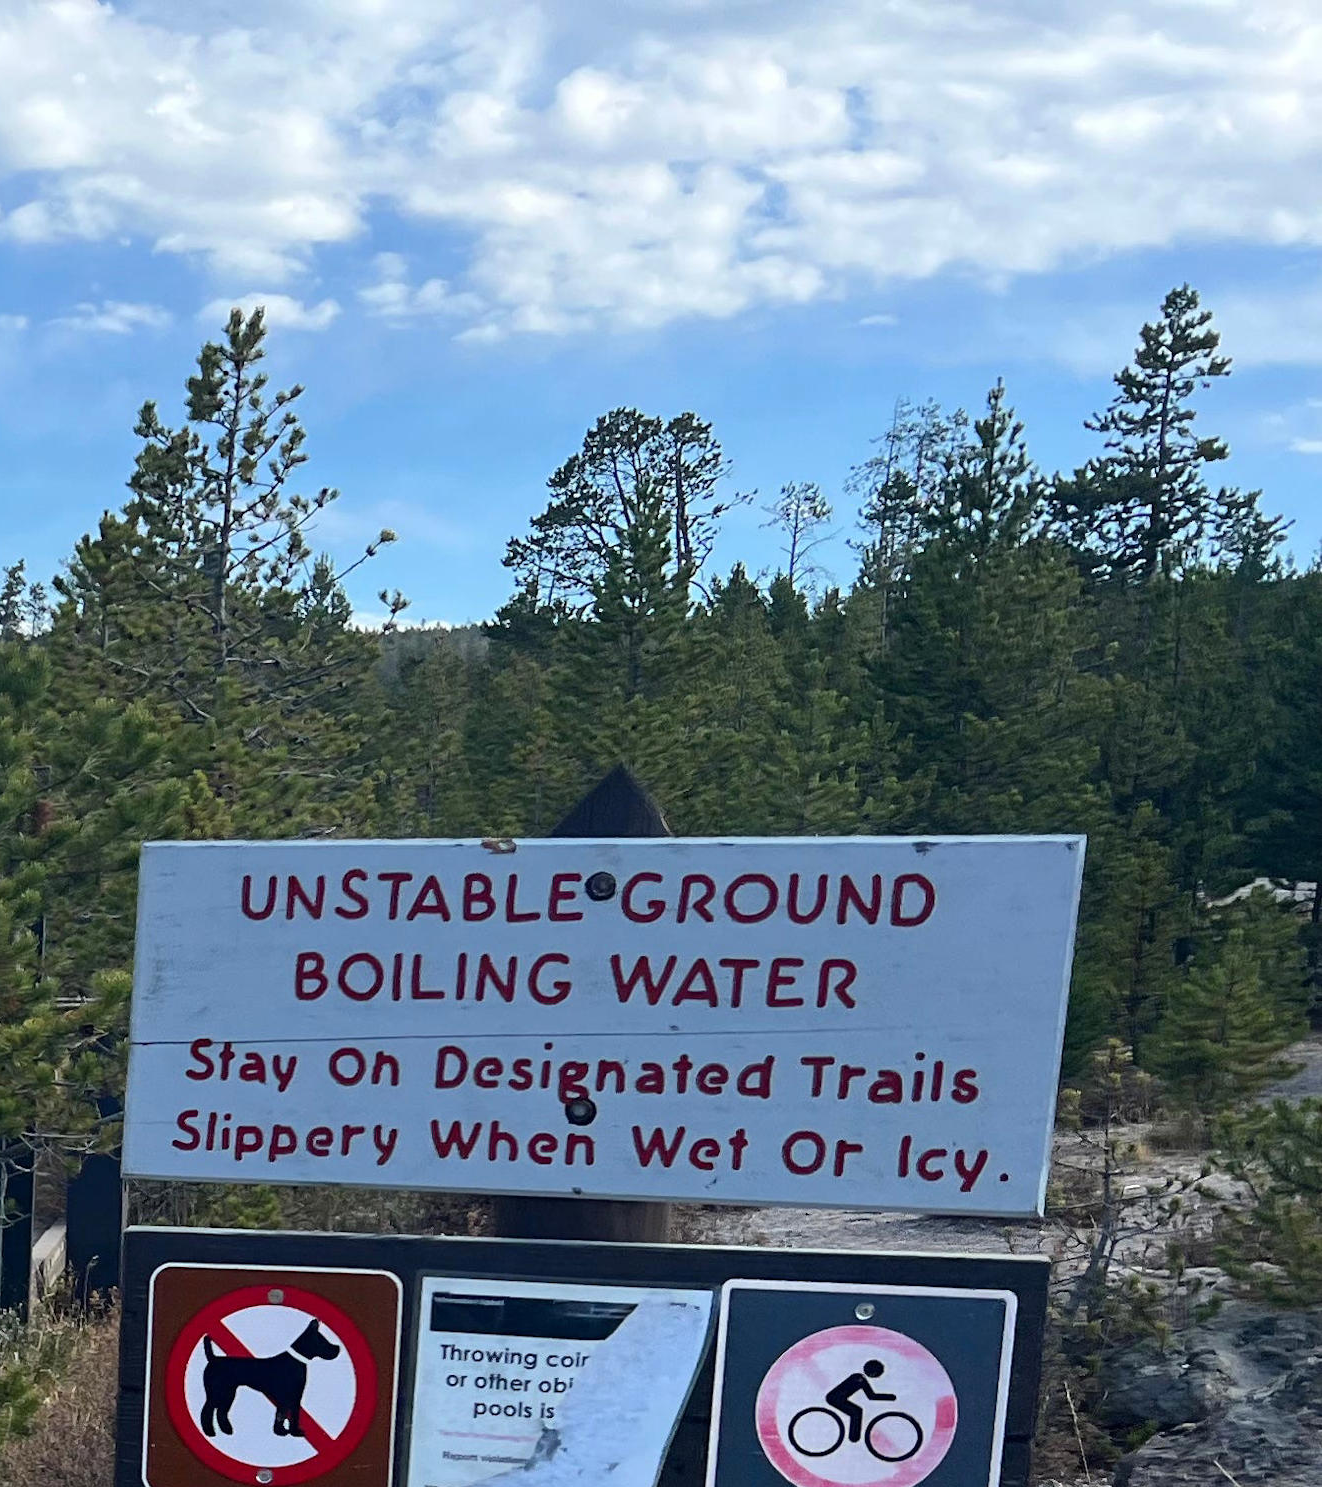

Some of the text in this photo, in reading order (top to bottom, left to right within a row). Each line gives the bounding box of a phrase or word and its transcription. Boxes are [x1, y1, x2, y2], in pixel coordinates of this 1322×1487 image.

[240, 871, 937, 927] UNSTABLE GROUND
[295, 951, 857, 1010] BOILING WATER
[185, 1038, 979, 1104] Stay On Designated Trails
[172, 1109, 1010, 1192] Slippery When Wet Or Icy.
[440, 1344, 537, 1370] Throwing
[446, 1374, 468, 1388] or
[474, 1374, 531, 1392] other
[473, 1402, 555, 1419] pools is
